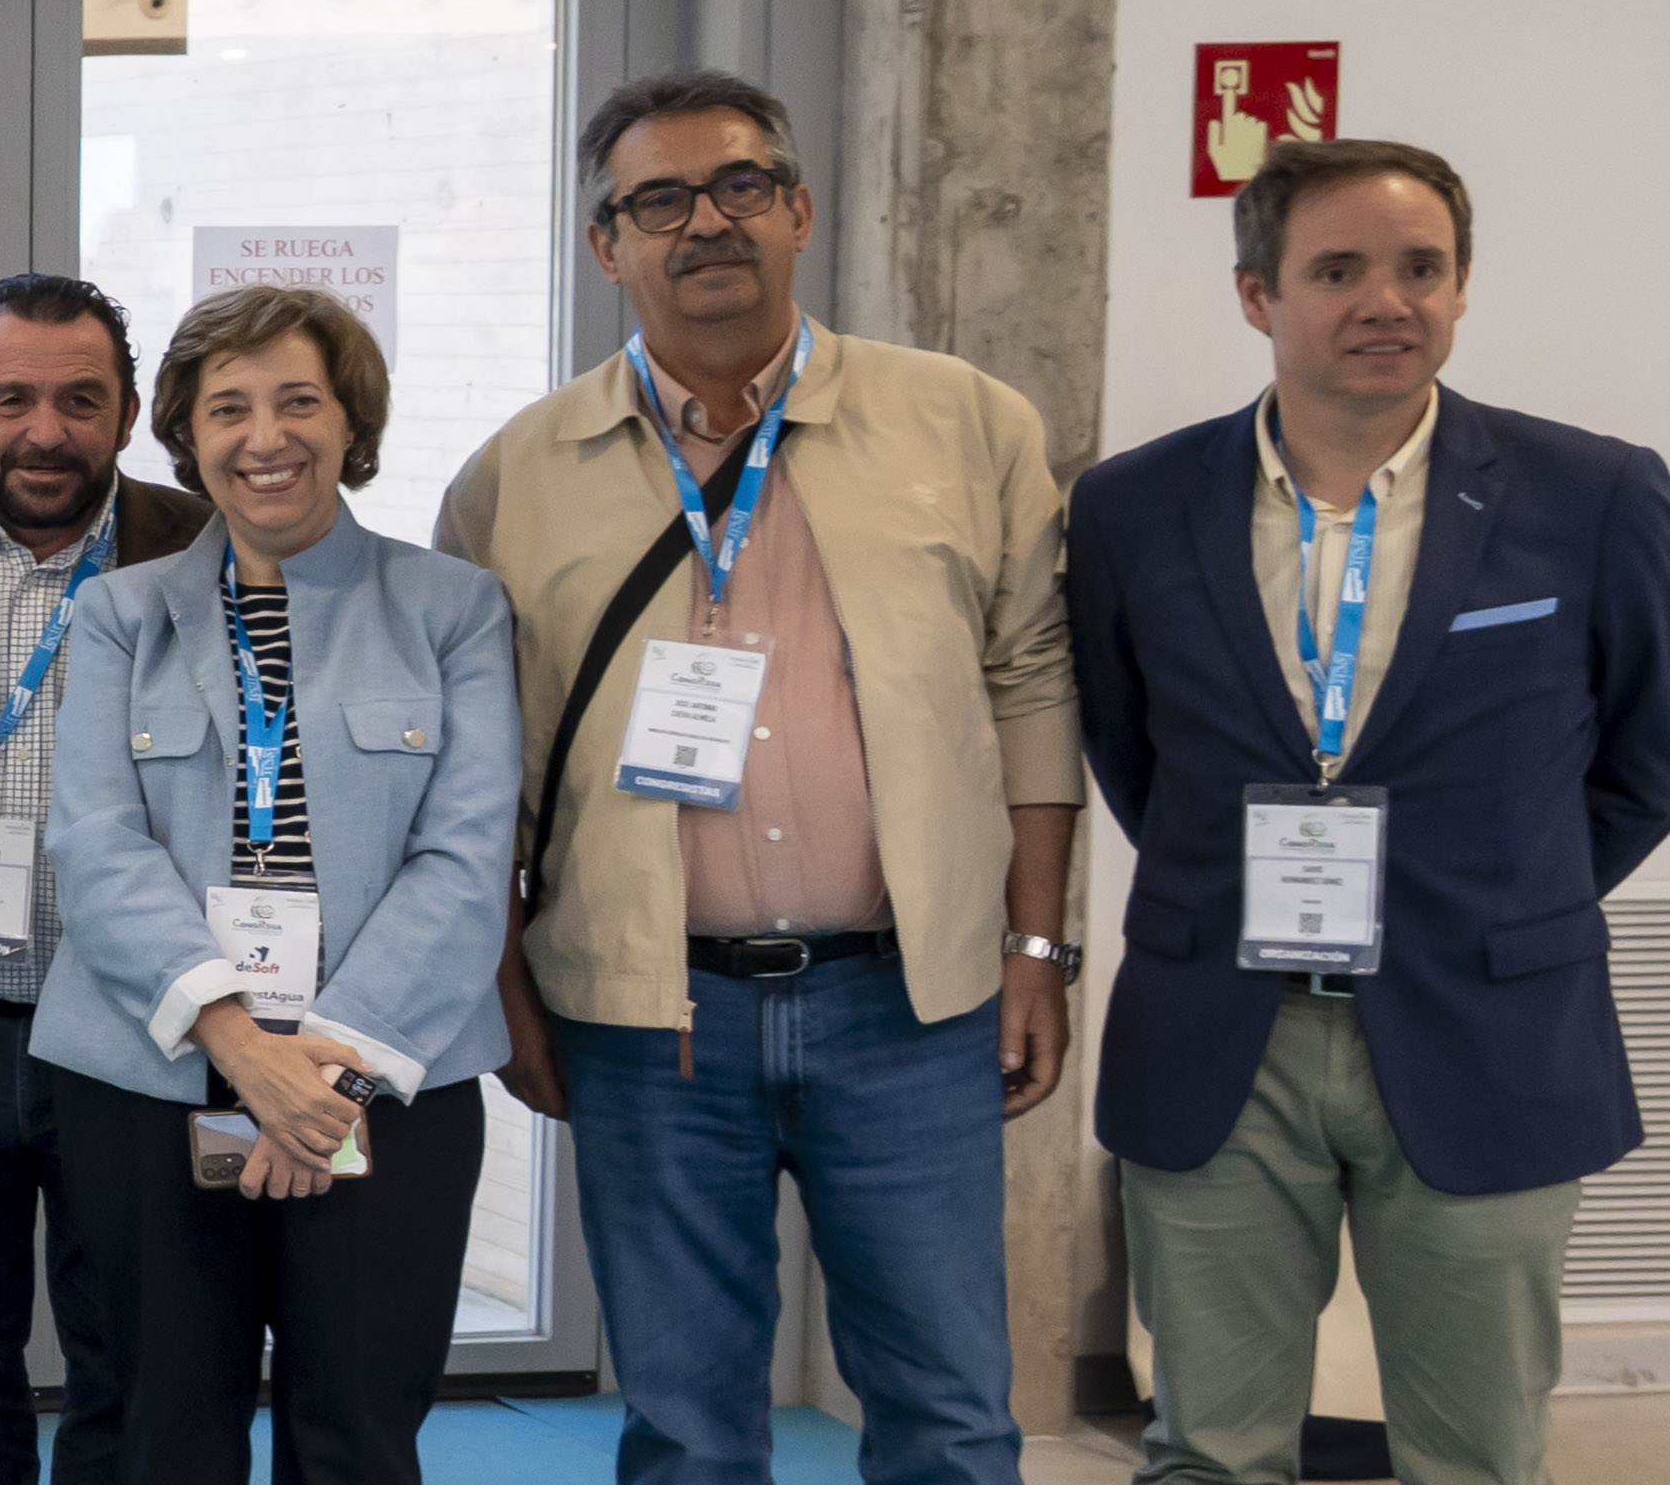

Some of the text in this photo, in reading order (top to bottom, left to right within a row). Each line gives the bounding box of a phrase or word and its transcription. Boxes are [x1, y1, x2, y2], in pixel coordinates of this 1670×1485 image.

[240, 238, 354, 258] SE RUEGA
[209, 266, 385, 286] ENCENDER LOS
